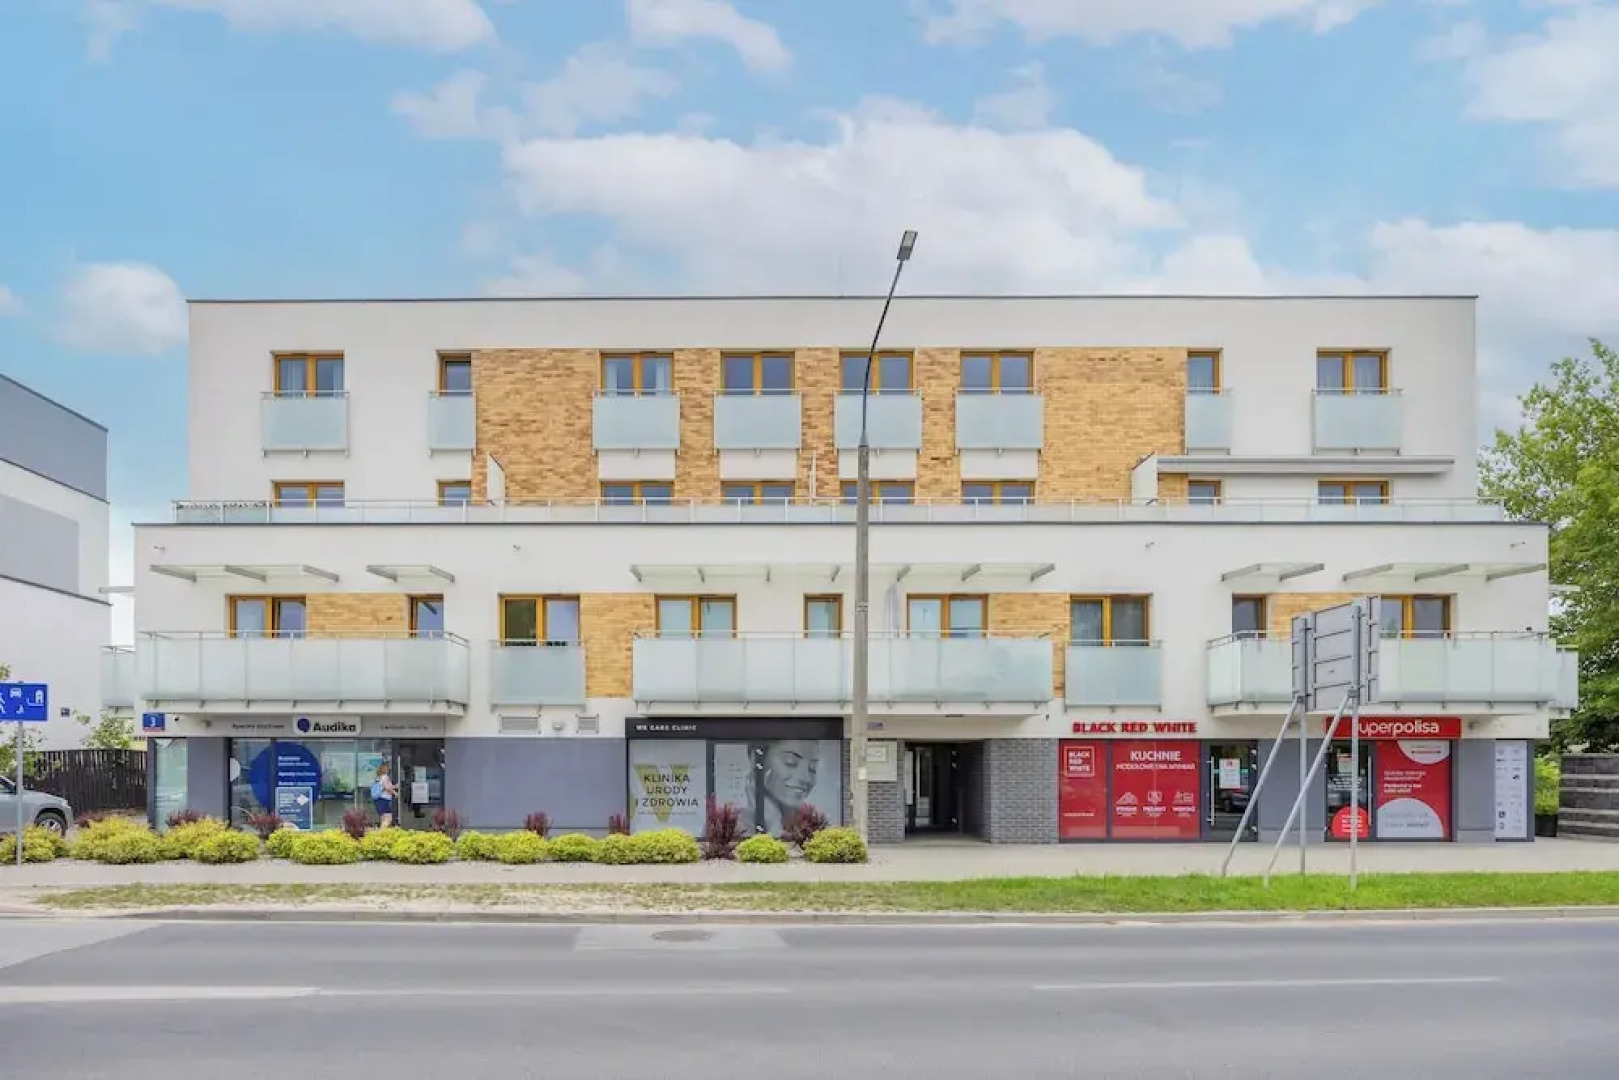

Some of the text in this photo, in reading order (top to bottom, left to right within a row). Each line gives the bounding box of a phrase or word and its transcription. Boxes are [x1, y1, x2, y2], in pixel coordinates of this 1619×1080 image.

[149, 716, 157, 728] 3
[313, 721, 357, 732] Audika
[1073, 722, 1197, 733] BLACK RED WHITE
[1352, 719, 1440, 736] uperpolisa
[1129, 750, 1182, 761] KUCHNIE
[643, 773, 691, 783] KLINIKA
[646, 786, 688, 795] URODY
[642, 798, 699, 807] ZDROWIA
